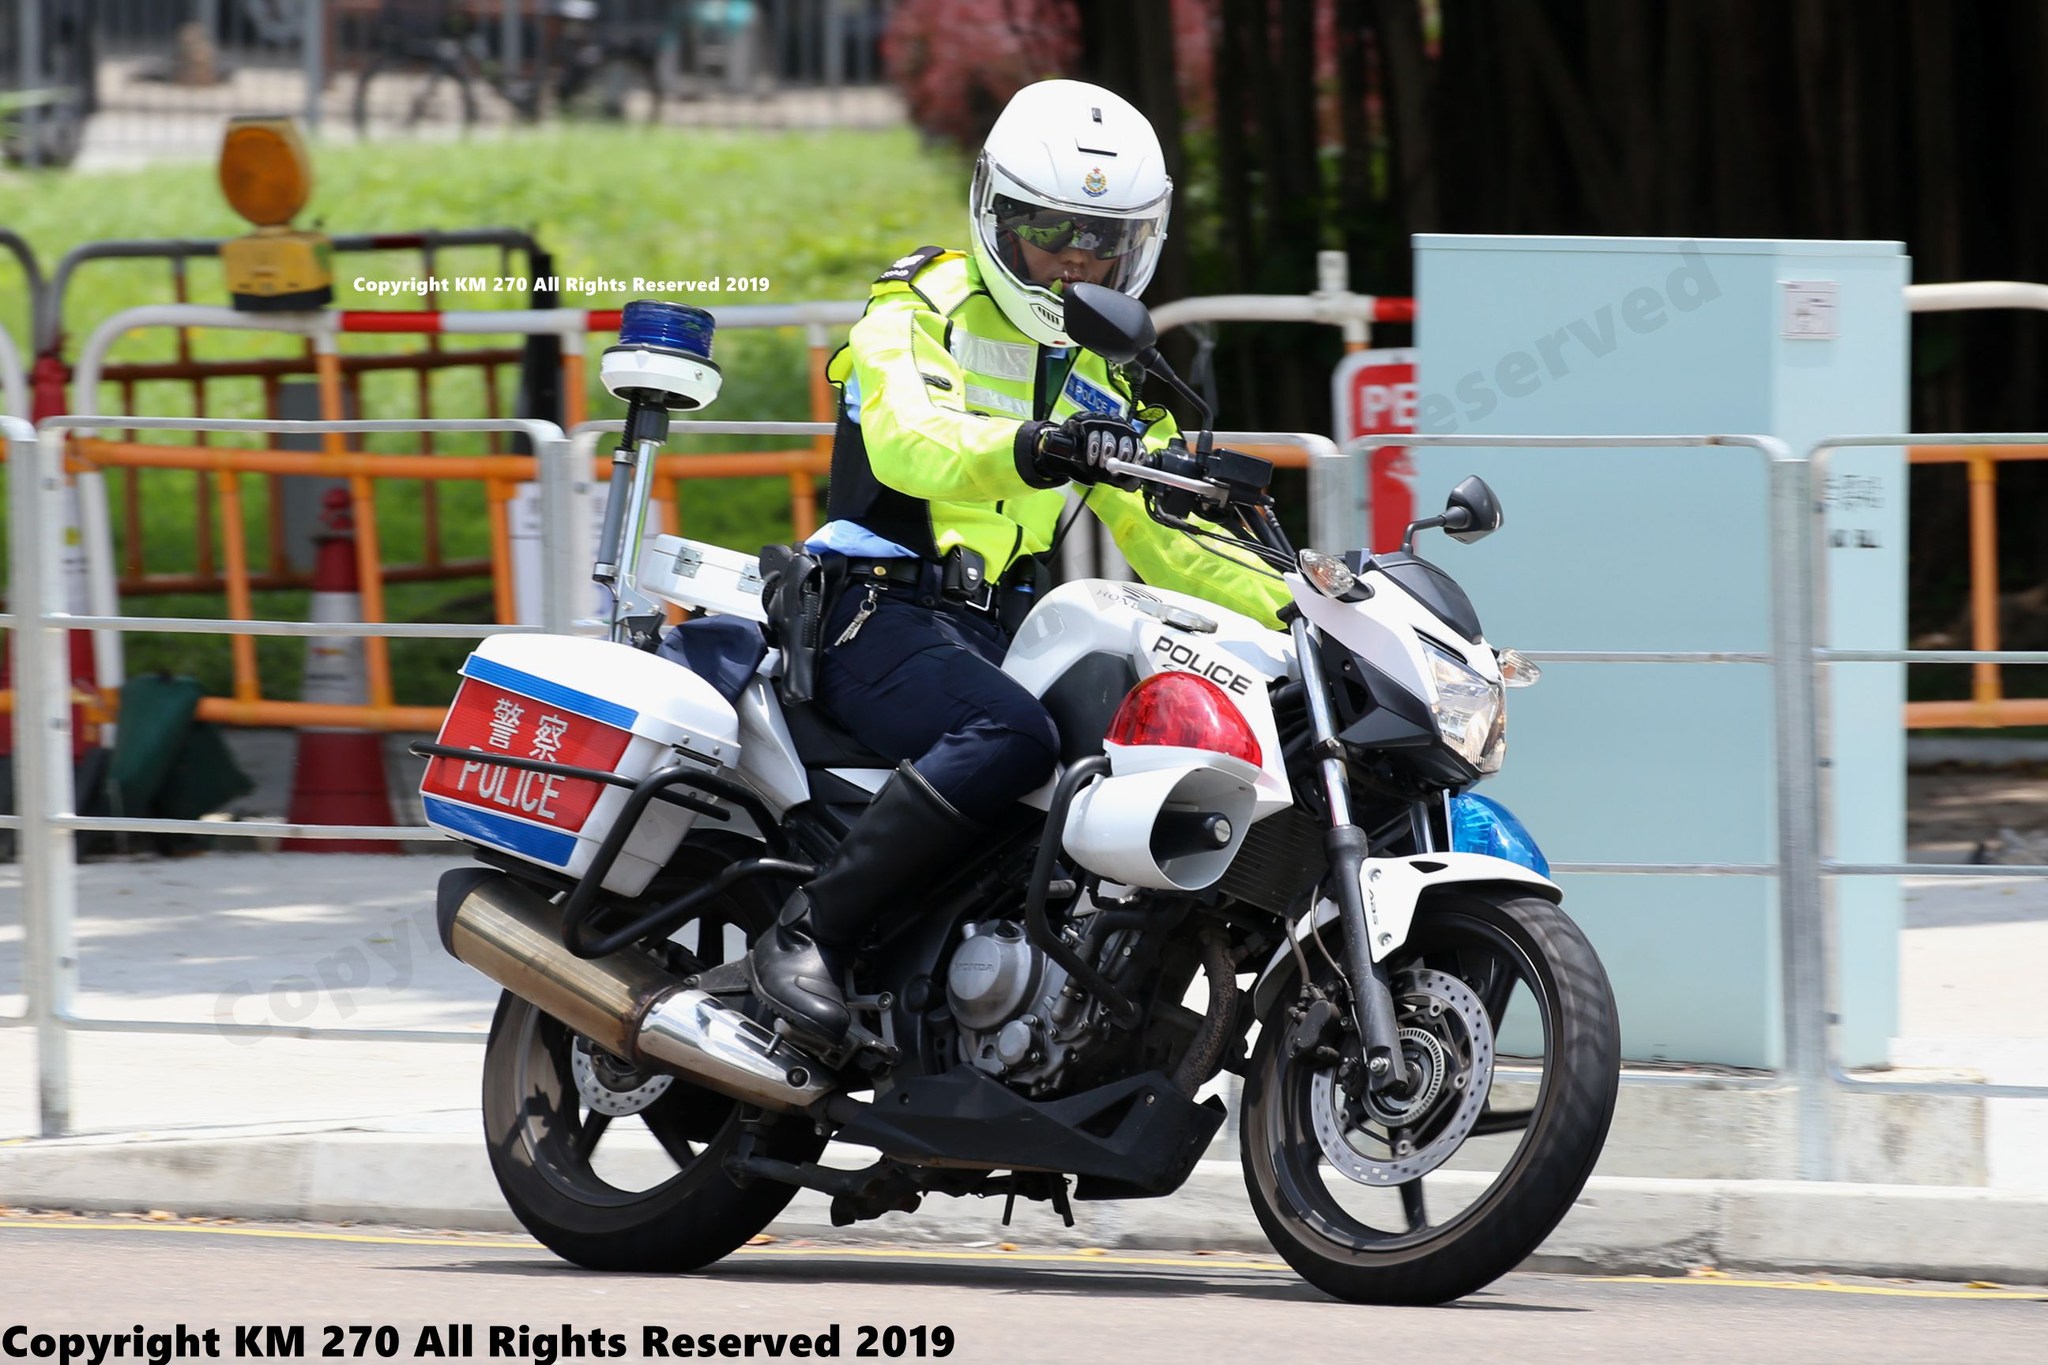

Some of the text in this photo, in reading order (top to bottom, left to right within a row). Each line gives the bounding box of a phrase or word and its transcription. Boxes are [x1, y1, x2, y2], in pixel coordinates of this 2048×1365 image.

[1075, 384, 1109, 412] POLICE
[1152, 635, 1253, 696] POLICE
[488, 697, 569, 764] 警察
[456, 745, 566, 820] POLICE
